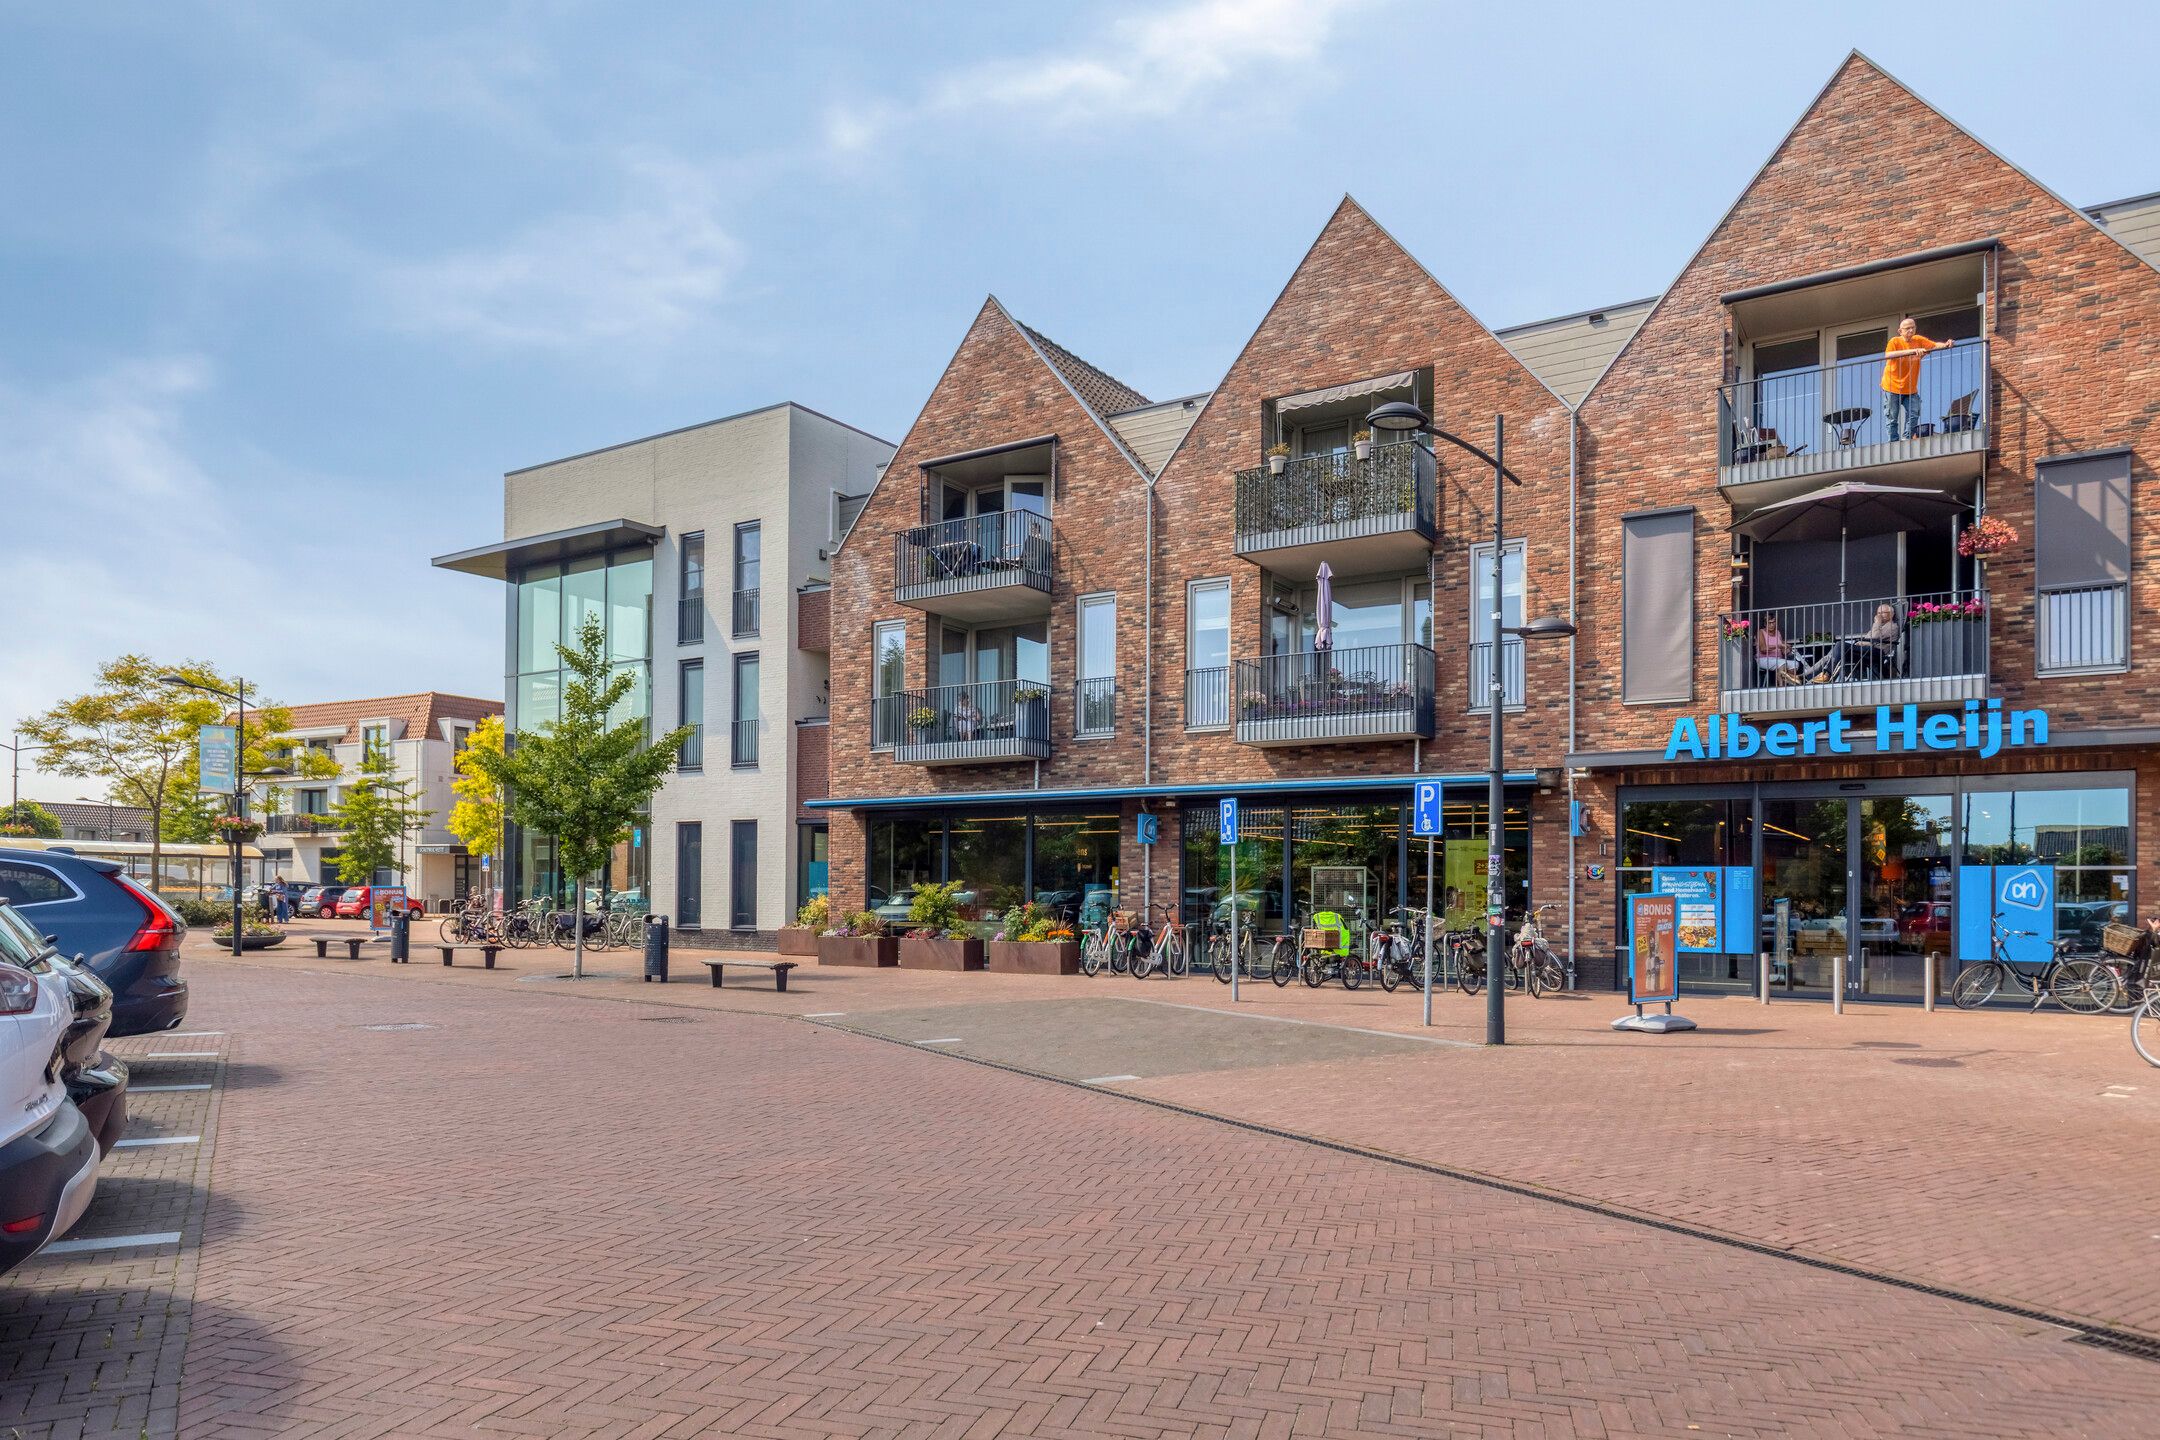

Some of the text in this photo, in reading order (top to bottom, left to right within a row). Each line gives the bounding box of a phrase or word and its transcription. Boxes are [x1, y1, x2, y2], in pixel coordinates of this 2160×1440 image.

[1664, 697, 2049, 760] Albert Heijn
[1420, 785, 1435, 812] P
[1223, 803, 1232, 826] P
[1643, 903, 1673, 916] BONUS
